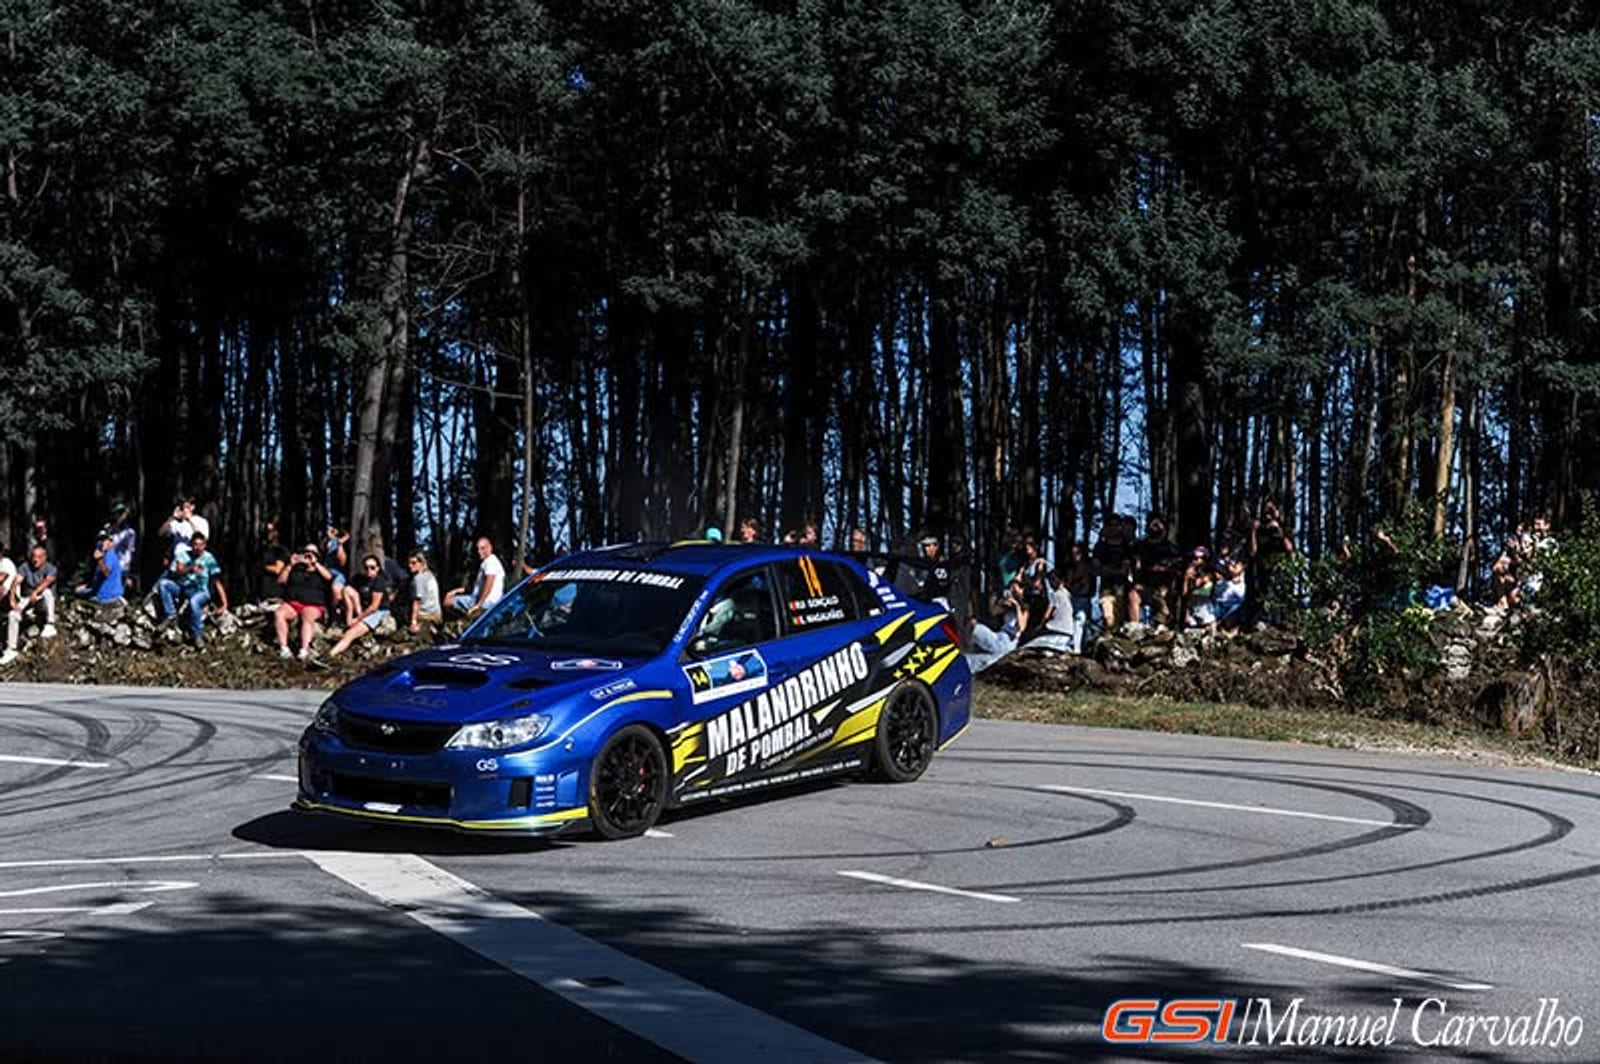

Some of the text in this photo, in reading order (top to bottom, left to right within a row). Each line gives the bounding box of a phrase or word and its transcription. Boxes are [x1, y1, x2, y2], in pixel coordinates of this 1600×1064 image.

[633, 572, 684, 589] POMBAL
[707, 642, 868, 759] MALANDRINHO
[476, 758, 498, 771] GS
[726, 747, 747, 776] DE
[751, 713, 812, 766] POMBAL
